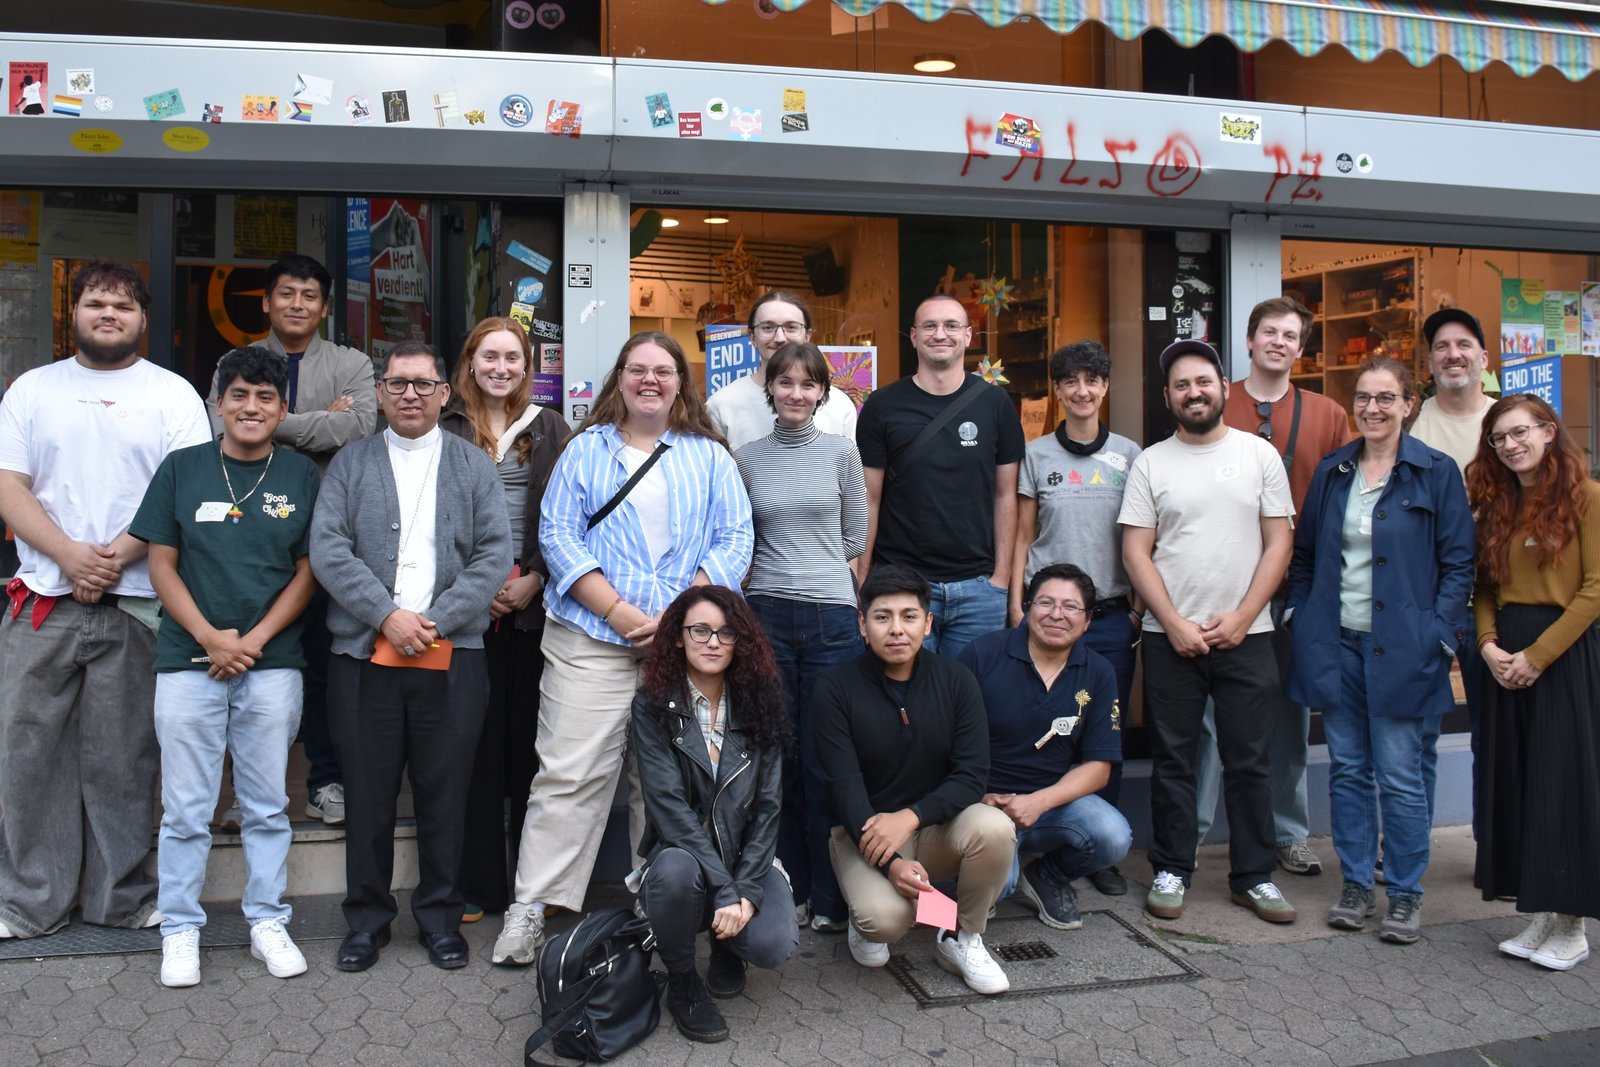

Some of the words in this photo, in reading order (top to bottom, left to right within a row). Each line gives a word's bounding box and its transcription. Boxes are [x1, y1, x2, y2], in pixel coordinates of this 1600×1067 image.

[347, 209, 367, 232] ENCE
[392, 250, 415, 271] Hart
[377, 274, 424, 298] verdient!
[711, 342, 744, 370] END
[1505, 368, 1529, 391] END
[1530, 362, 1553, 385] THE
